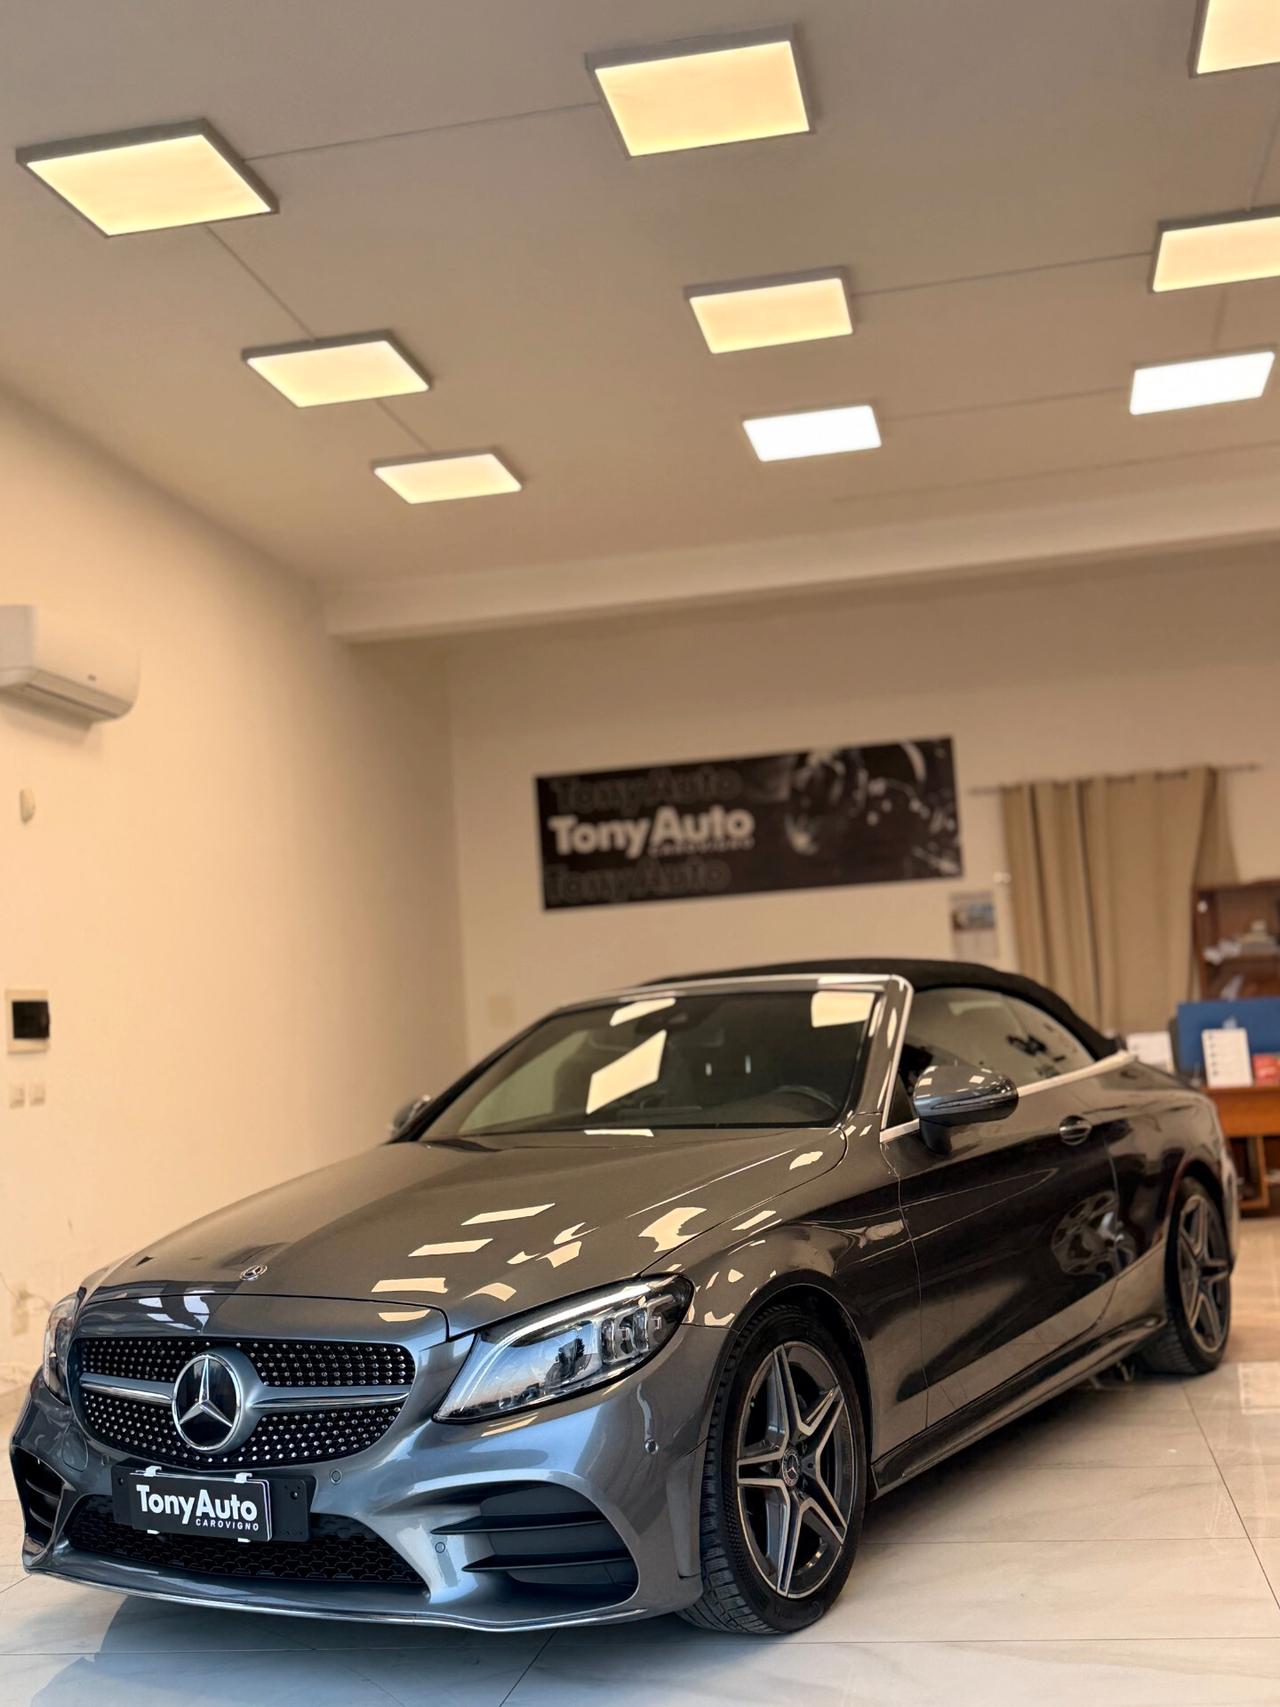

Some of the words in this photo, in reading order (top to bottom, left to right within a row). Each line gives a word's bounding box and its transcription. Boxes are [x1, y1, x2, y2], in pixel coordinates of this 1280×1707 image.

[548, 805, 755, 858] TonyAuto
[136, 1484, 258, 1524] TonyAuto
[195, 1518, 260, 1531] CAROVIGNO
